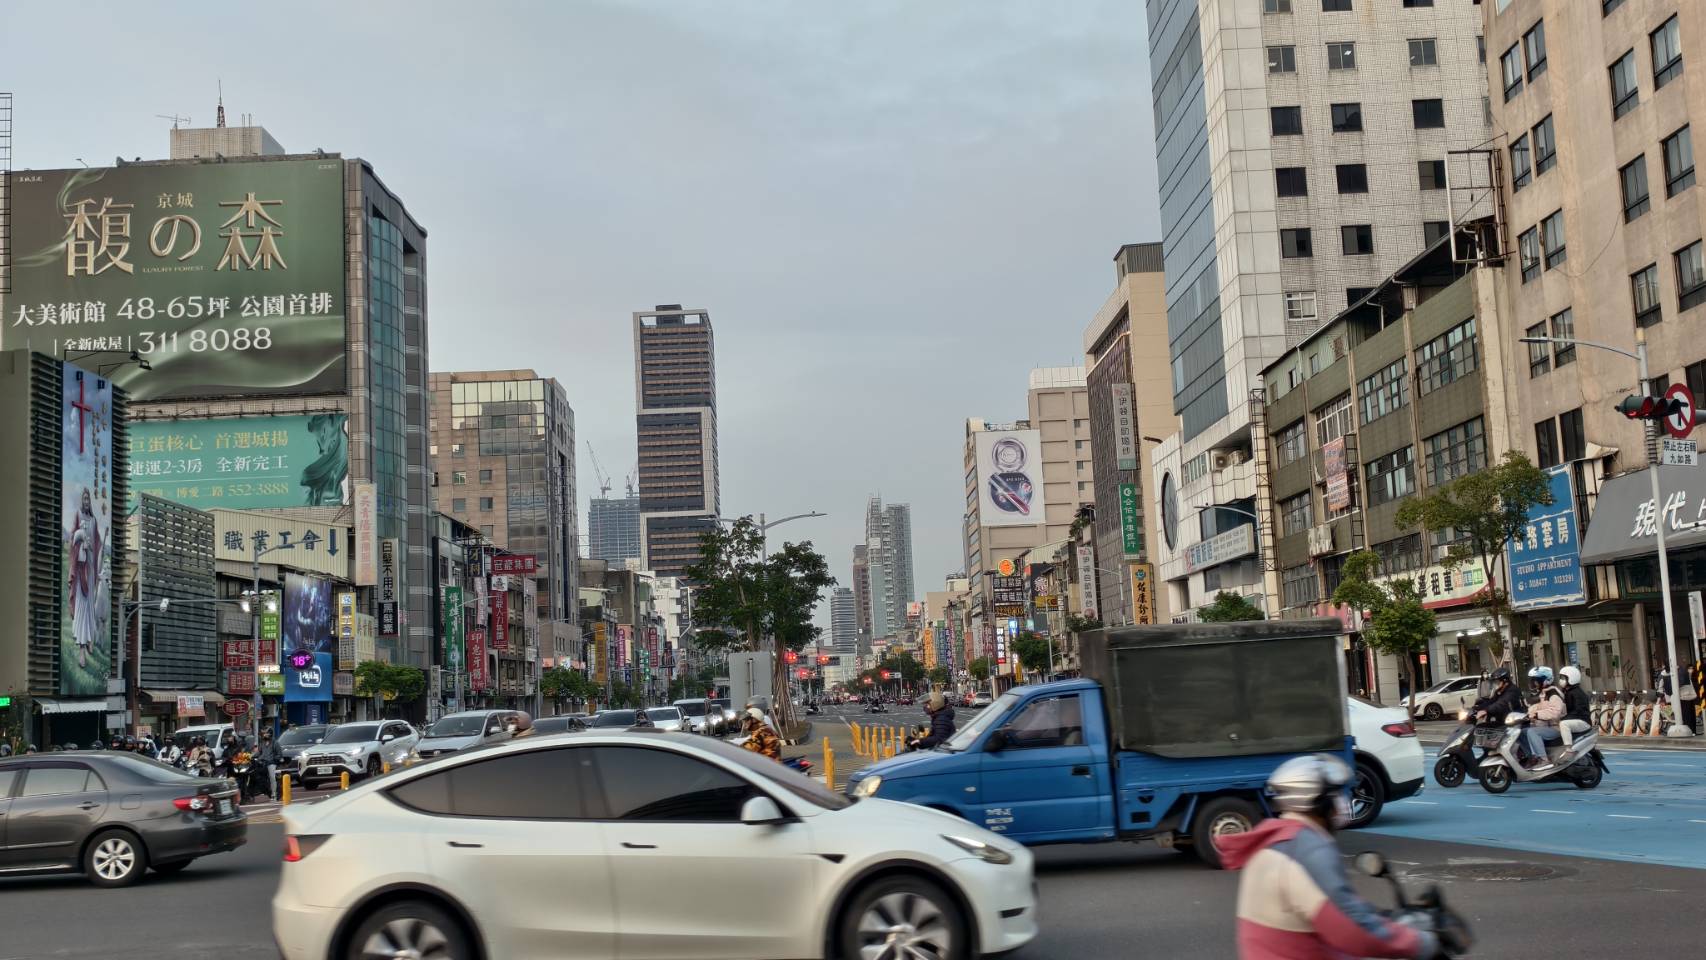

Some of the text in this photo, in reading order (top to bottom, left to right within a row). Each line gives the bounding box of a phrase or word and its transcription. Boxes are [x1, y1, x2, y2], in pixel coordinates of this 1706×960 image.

[156, 192, 194, 209] 京城
[63, 192, 287, 276] 馥の森
[12, 292, 333, 327] 大美術館 48-65坪 公園首排
[64, 328, 272, 355] 全新成屋 311 8088
[128, 431, 288, 452] 巨蛋核心 首選城揚
[1664, 440, 1697, 452] 禁止左右轉
[128, 455, 288, 476] 捷運2-3房 全新完工
[1670, 454, 1692, 465] 九如路
[1123, 498, 1136, 549] 合作金庫銀行
[1631, 490, 1706, 537] 現代
[224, 529, 320, 552] 職業工會
[382, 541, 394, 601] 白髮不用染
